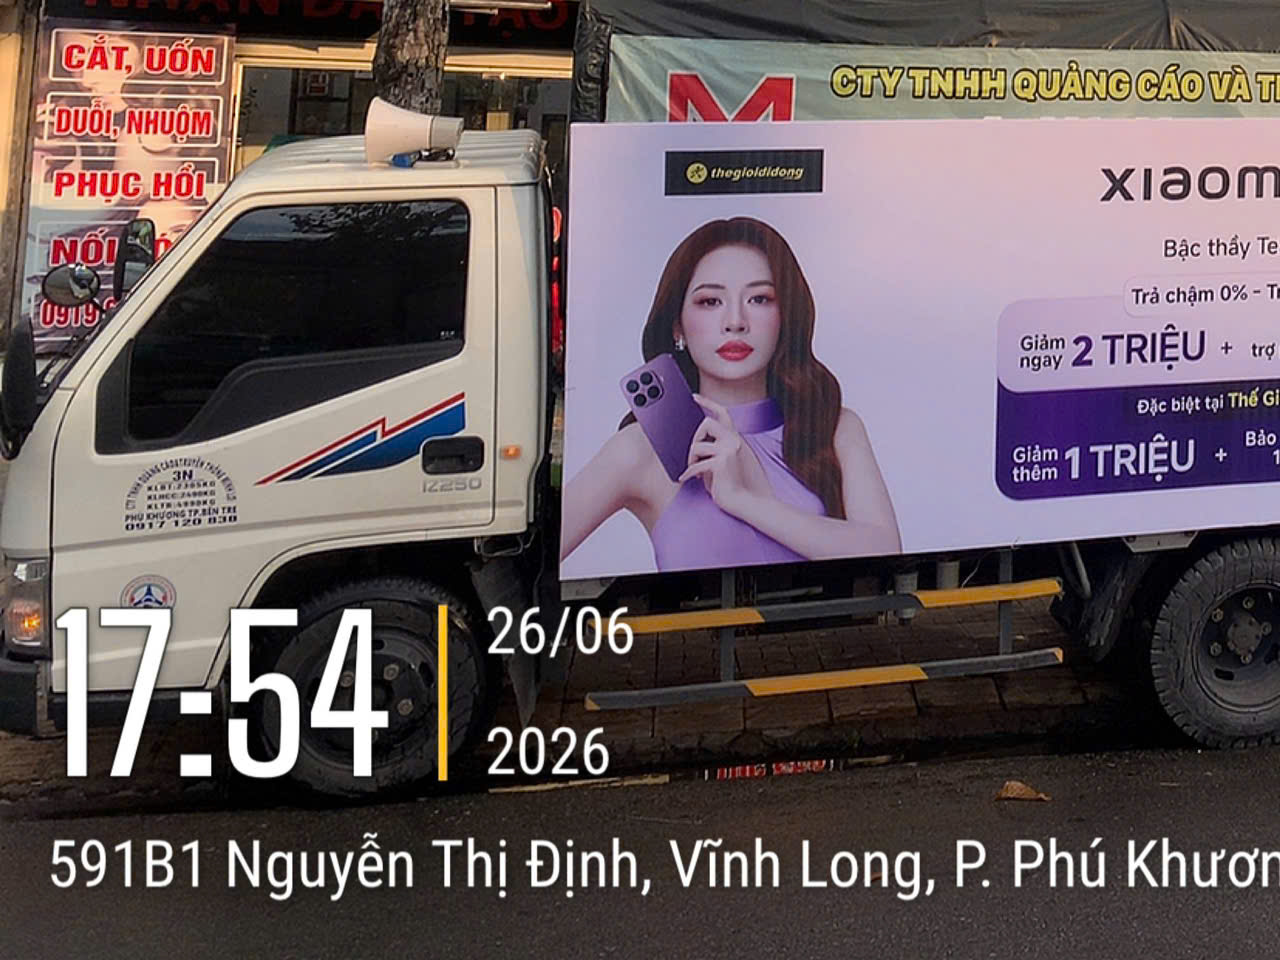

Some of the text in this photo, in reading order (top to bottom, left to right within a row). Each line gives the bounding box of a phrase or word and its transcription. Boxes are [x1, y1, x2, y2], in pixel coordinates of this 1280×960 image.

[63, 34, 215, 74] CẮT, UỐN
[831, 64, 904, 99] CTY
[907, 66, 1006, 100] TNHH
[1012, 60, 1132, 103] QUẢNG
[1136, 63, 1203, 102] CÁO
[1209, 64, 1252, 103] VÀ
[127, 104, 213, 142] NHUỘM
[710, 166, 804, 181] thegioididong
[54, 171, 141, 203] PHỤC
[50, 229, 118, 266] NỐI
[1163, 239, 1201, 262] Bậc
[1131, 286, 1159, 305] Trả
[1166, 285, 1214, 307] chậm
[1220, 285, 1248, 301] 0%
[41, 298, 99, 328] 0919
[1020, 333, 1065, 352] Giảm
[1071, 335, 1093, 367] 2
[1101, 323, 1206, 371] TRIỆU
[1252, 342, 1275, 360] trợ
[1019, 354, 1063, 371] ngay
[1137, 397, 1167, 417] Đặc
[1171, 395, 1201, 416] biệt
[1204, 393, 1224, 413] tại
[1228, 387, 1259, 408] Thế
[1245, 428, 1277, 447] Bảo
[1012, 444, 1058, 464] Giảm
[1064, 446, 1080, 479] 1
[1089, 433, 1195, 482] TRIỆU
[172, 469, 193, 481] 3N
[1012, 465, 1058, 483] thêm
